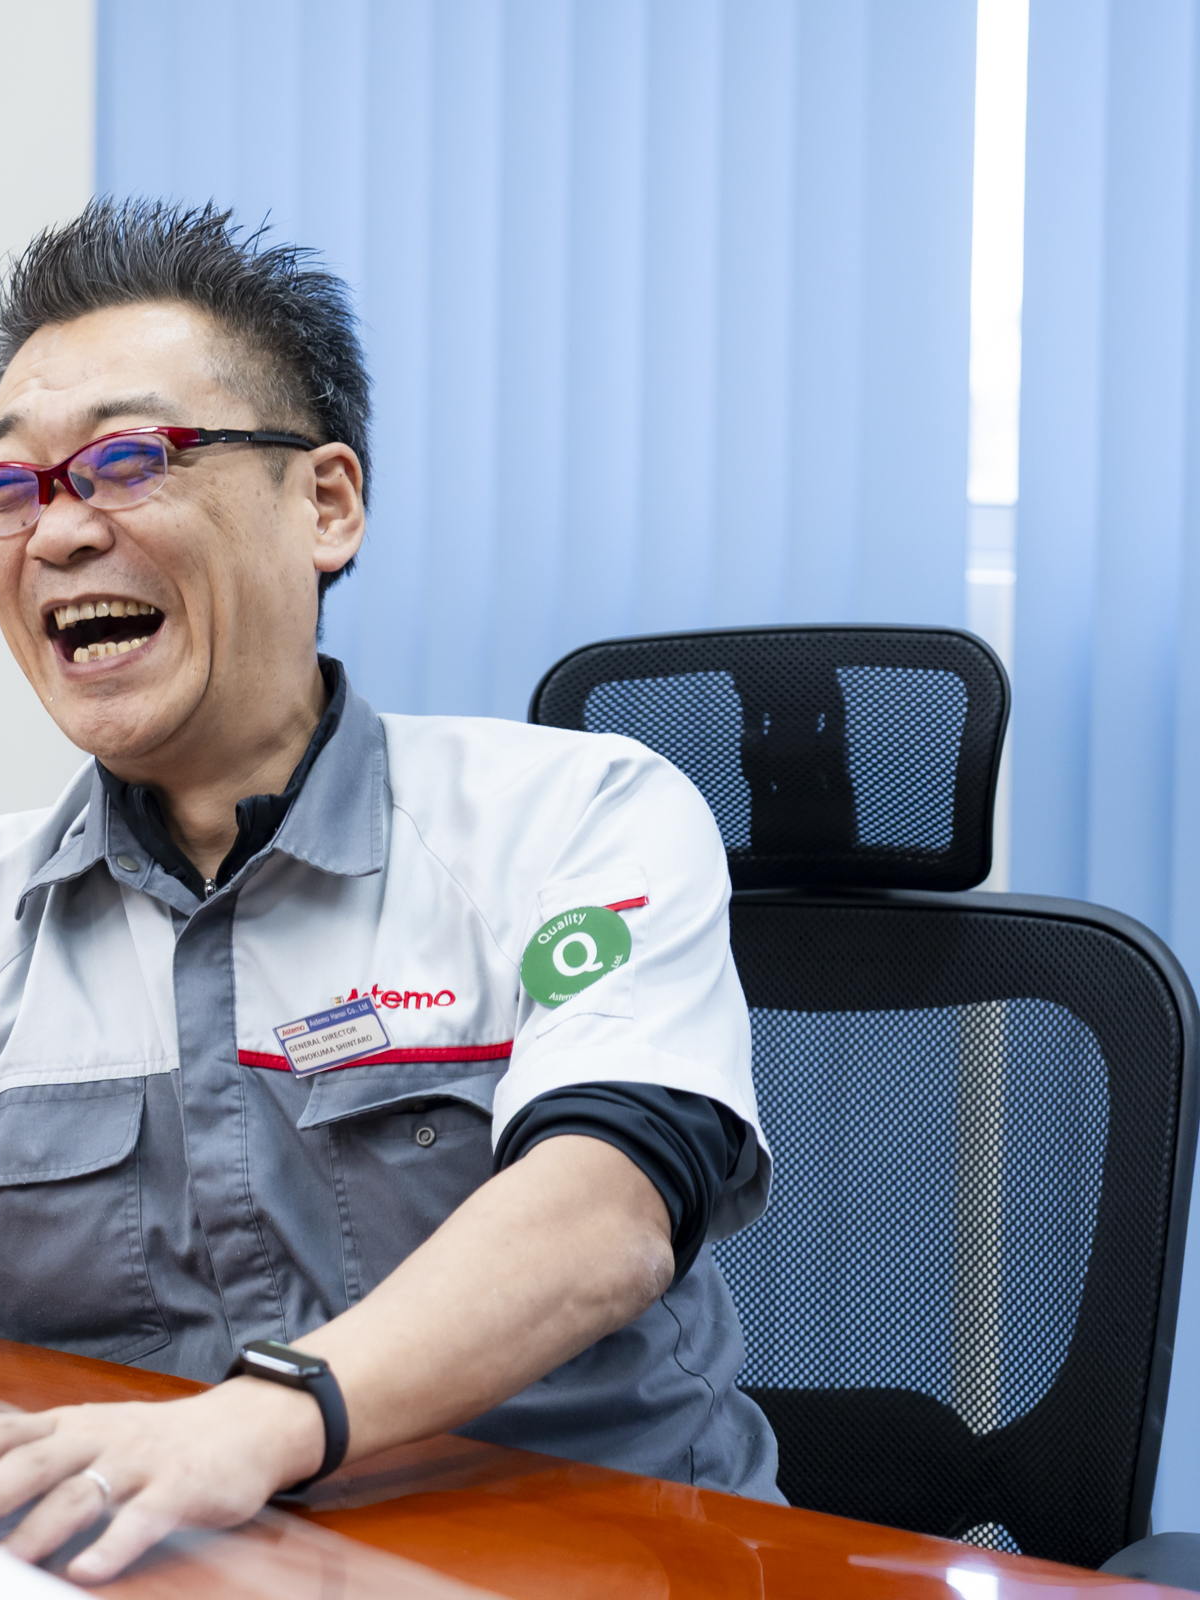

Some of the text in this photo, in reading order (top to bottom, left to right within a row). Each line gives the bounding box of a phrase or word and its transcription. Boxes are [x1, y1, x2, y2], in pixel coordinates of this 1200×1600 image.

[538, 913, 586, 944] Quality
[552, 931, 604, 977] Q
[282, 1024, 305, 1037] Astemo
[309, 1016, 330, 1027] Astemo
[330, 1010, 347, 1020] Hanoi
[289, 1026, 357, 1053] GENERAL DIRECTOR
[294, 1035, 373, 1064] HINOKUMA SHINTARO
